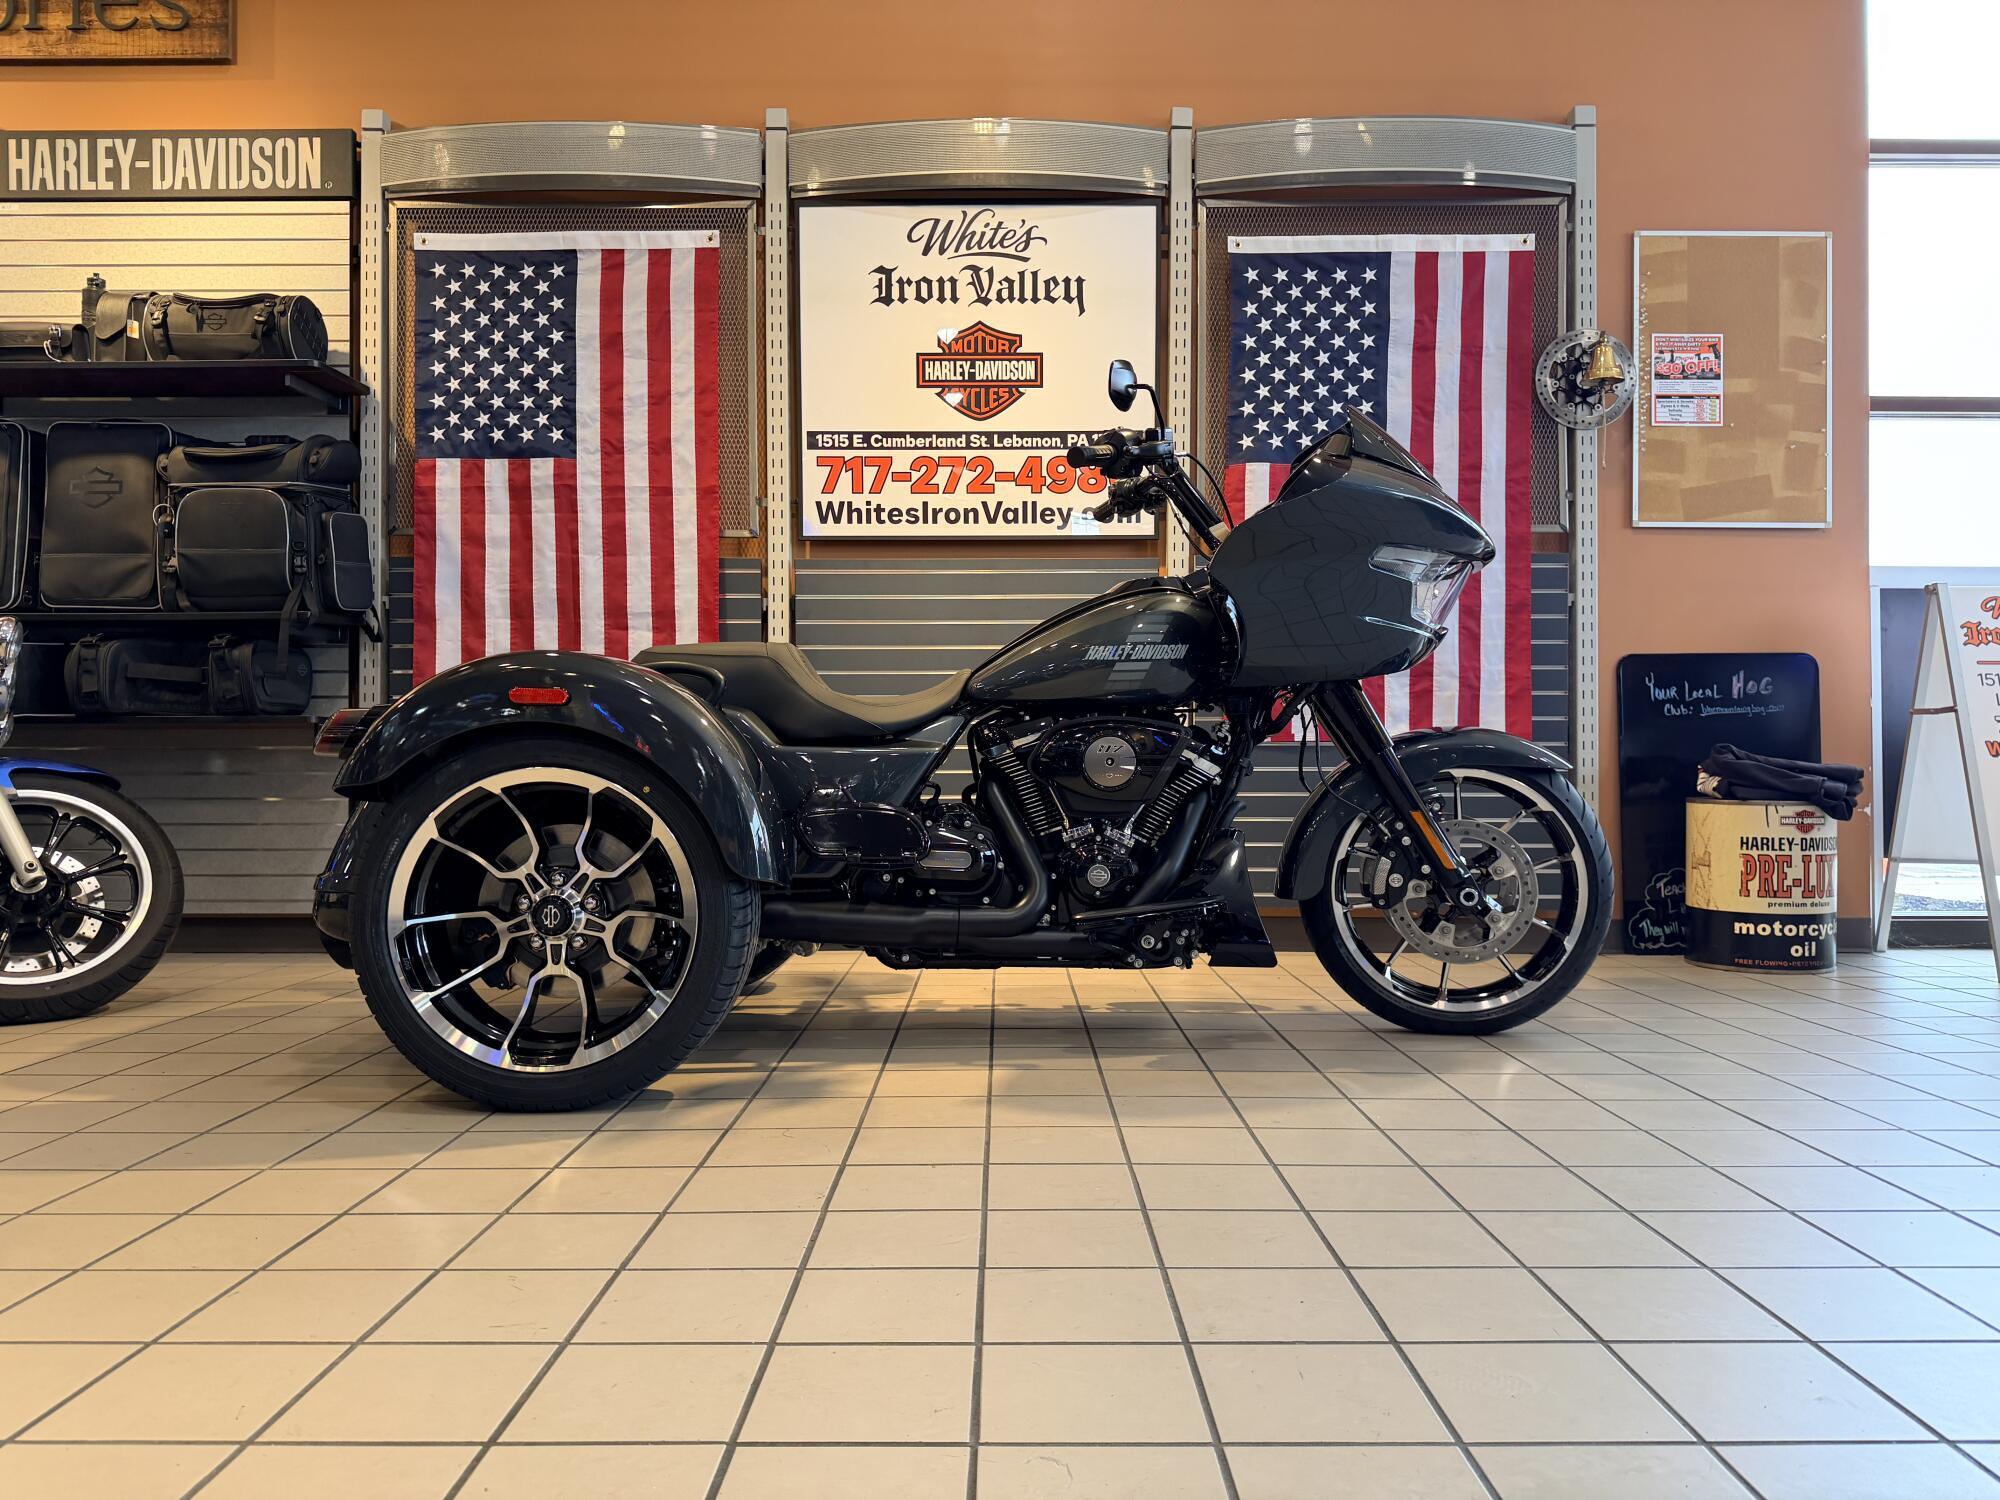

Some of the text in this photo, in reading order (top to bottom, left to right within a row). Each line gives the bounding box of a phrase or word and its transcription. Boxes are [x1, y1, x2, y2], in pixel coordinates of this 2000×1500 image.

[7, 137, 322, 191] HARLEY-DAVIDSON
[906, 208, 1048, 262] White's
[868, 264, 1087, 317] Iron Valley
[951, 331, 1010, 353] MOTOR
[925, 360, 1036, 380] HARLEY-DAVIDSON
[815, 434, 849, 447] 1515
[852, 434, 868, 447] E.
[870, 434, 966, 448] Cumberland
[969, 434, 990, 448] St.
[993, 434, 1064, 449] Lebanon,
[1067, 433, 1090, 447] PA
[816, 455, 1118, 495] 717-272-498
[815, 500, 1141, 530] WhitesIronValleycm
[1960, 620, 2000, 647] Iro
[1084, 644, 1189, 660] HARLEY-DAVIDSON
[1977, 672, 2000, 686] 151
[1739, 853, 1837, 899] PRE-LUX
[1733, 920, 1838, 940] motorcycl
[1790, 942, 1817, 957] oil
